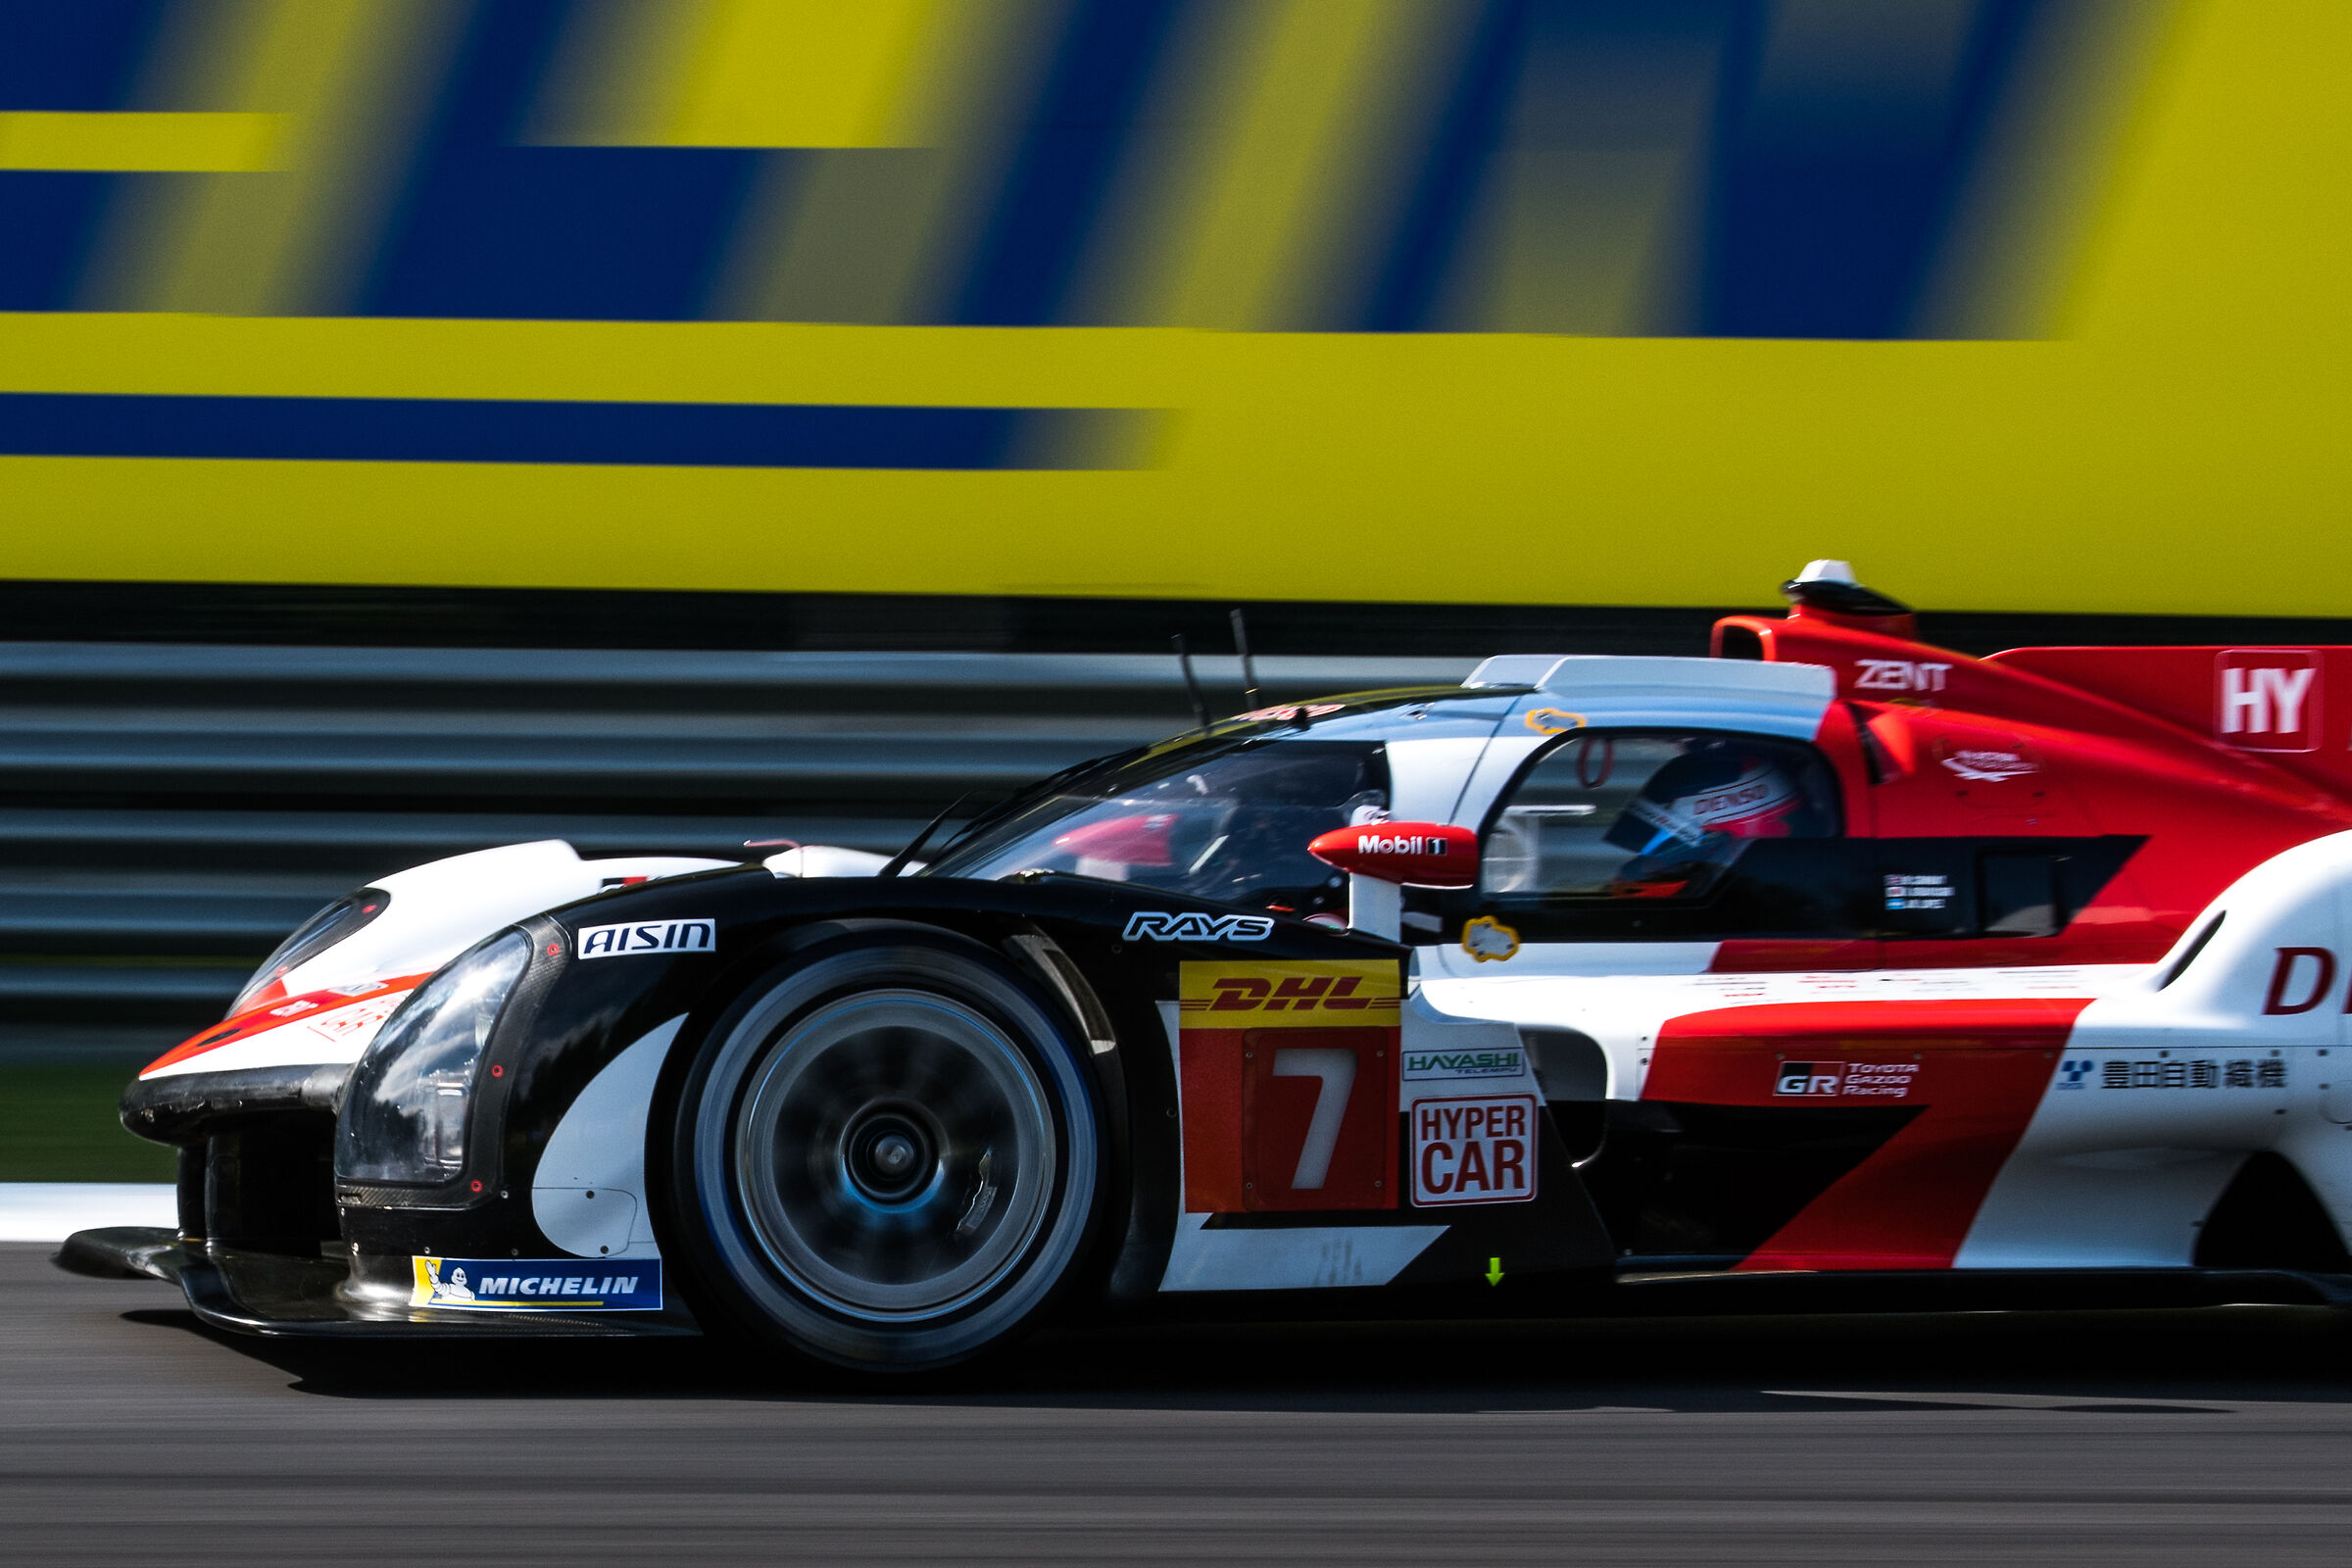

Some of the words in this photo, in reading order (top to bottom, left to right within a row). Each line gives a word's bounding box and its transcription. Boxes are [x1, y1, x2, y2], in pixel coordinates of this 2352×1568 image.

[1854, 659, 1954, 692] ZENT
[2220, 667, 2316, 734] HY
[1693, 783, 1769, 815] DENSO
[1357, 835, 1423, 855] Mobil
[583, 923, 711, 954] AISIN
[1122, 911, 1274, 941] RAYS
[1209, 976, 1372, 1011] DHL
[2260, 947, 2352, 1015] D
[1407, 1052, 1520, 1070] HAYASHI
[1776, 1075, 1839, 1094] GR
[1841, 1085, 1909, 1098] Racing
[1274, 1048, 1359, 1190] 7
[1421, 1104, 1526, 1141] HYPER
[1421, 1139, 1526, 1195] CAR
[478, 1276, 639, 1295] MICHELIN
